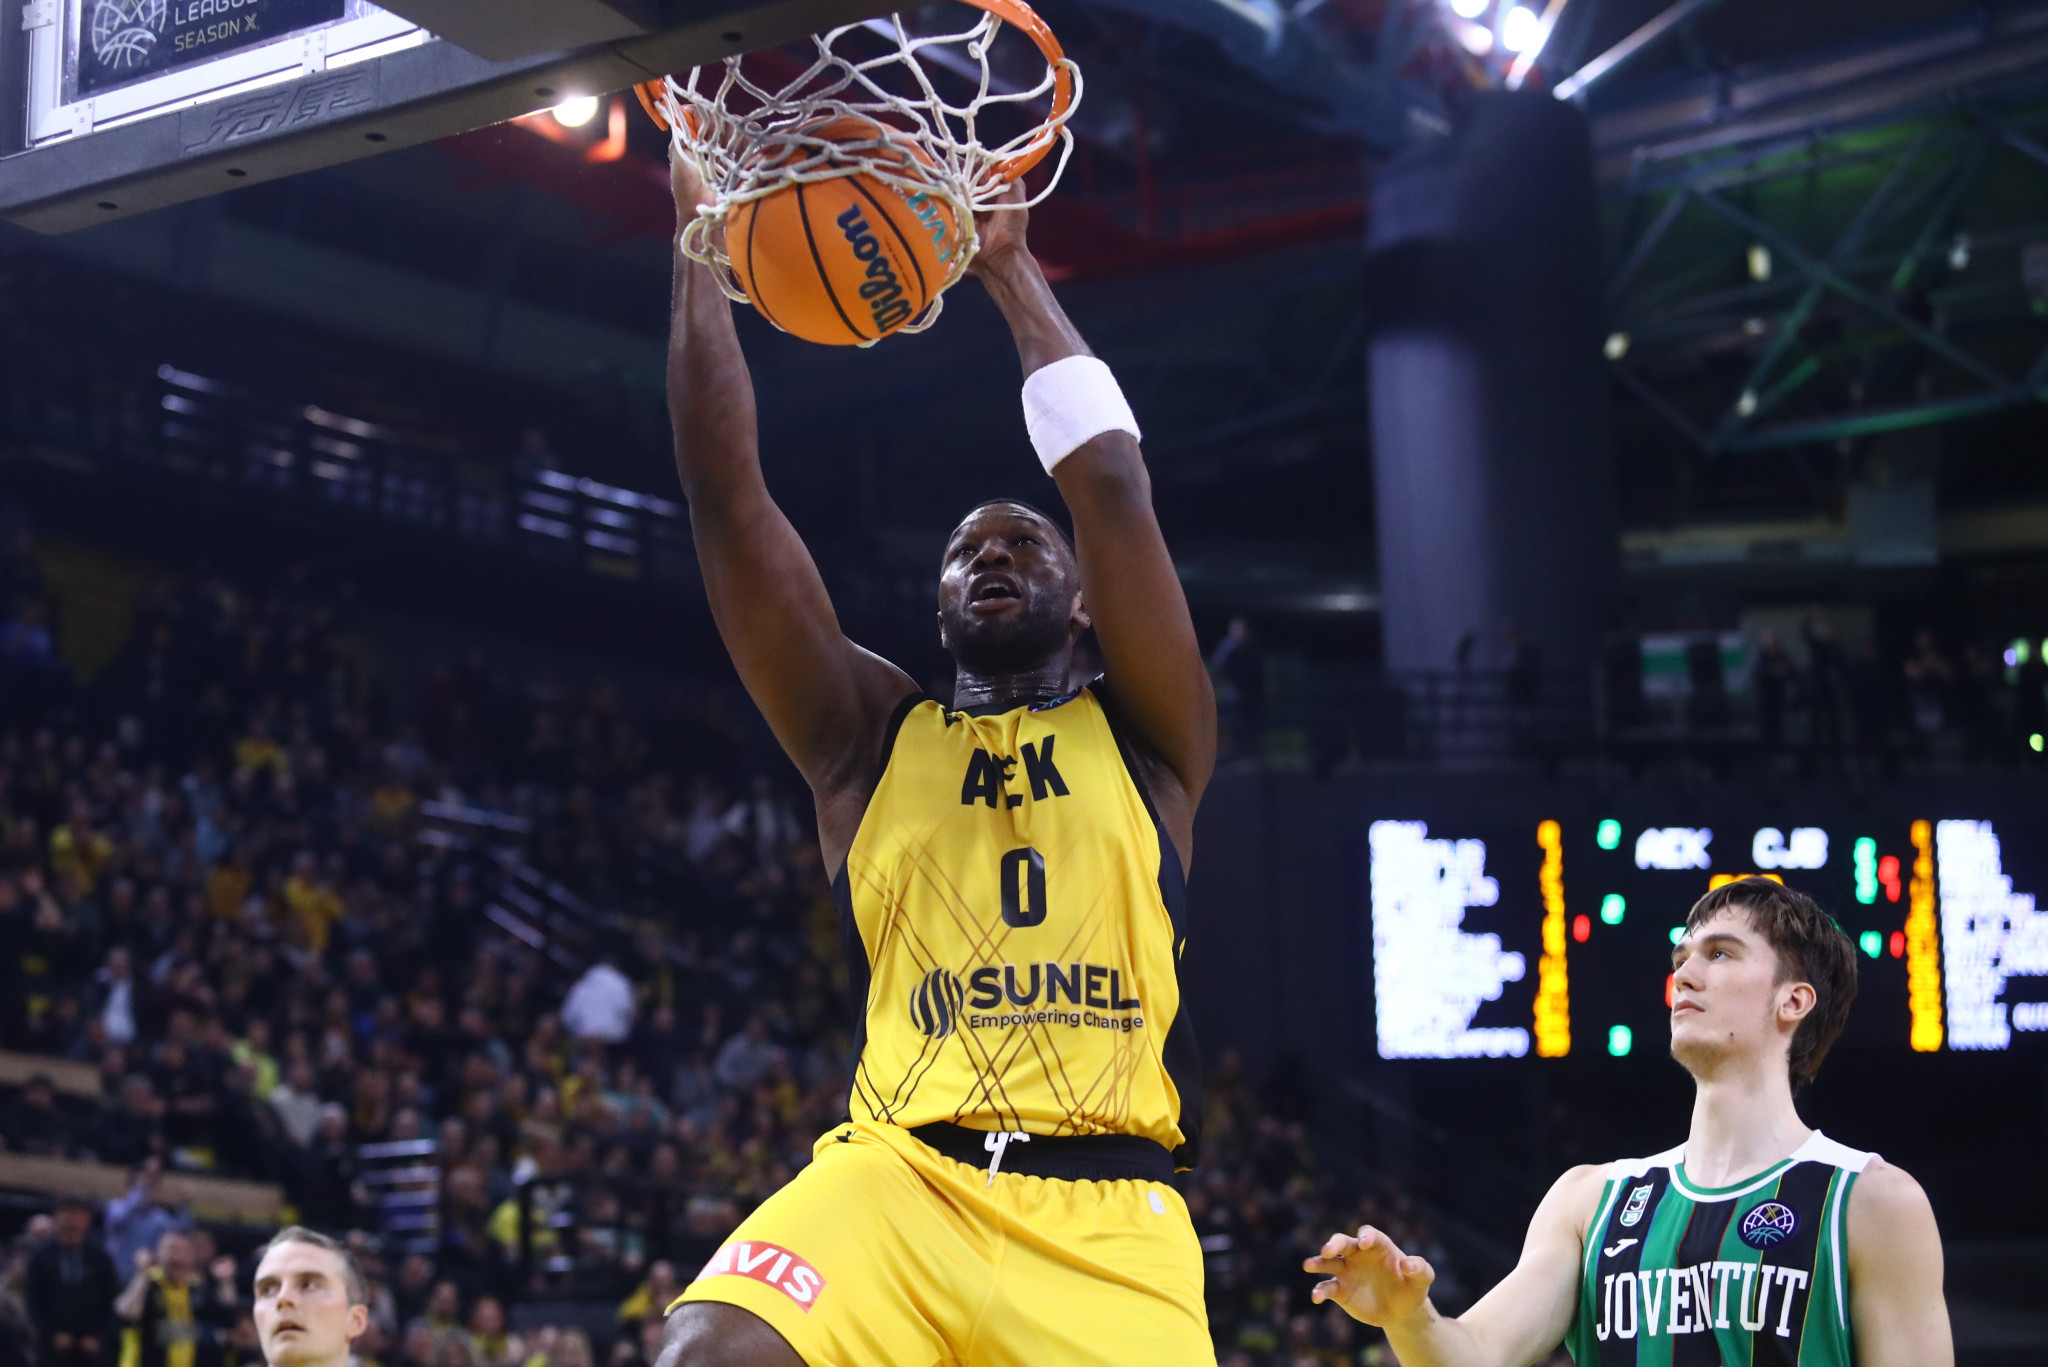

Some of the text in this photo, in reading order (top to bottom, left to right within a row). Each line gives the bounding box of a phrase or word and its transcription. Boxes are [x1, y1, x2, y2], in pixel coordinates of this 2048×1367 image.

[174, 18, 240, 53] SEASON
[175, 0, 258, 26] LEAG
[837, 202, 913, 333] Wilson
[961, 733, 1071, 811] AEK
[1000, 846, 1047, 929] 0
[969, 962, 1141, 1011] SUNEL
[970, 1009, 1144, 1033] Empowering Change
[702, 1243, 820, 1303] AVIS
[1596, 1261, 1809, 1342] JOVENTUT
